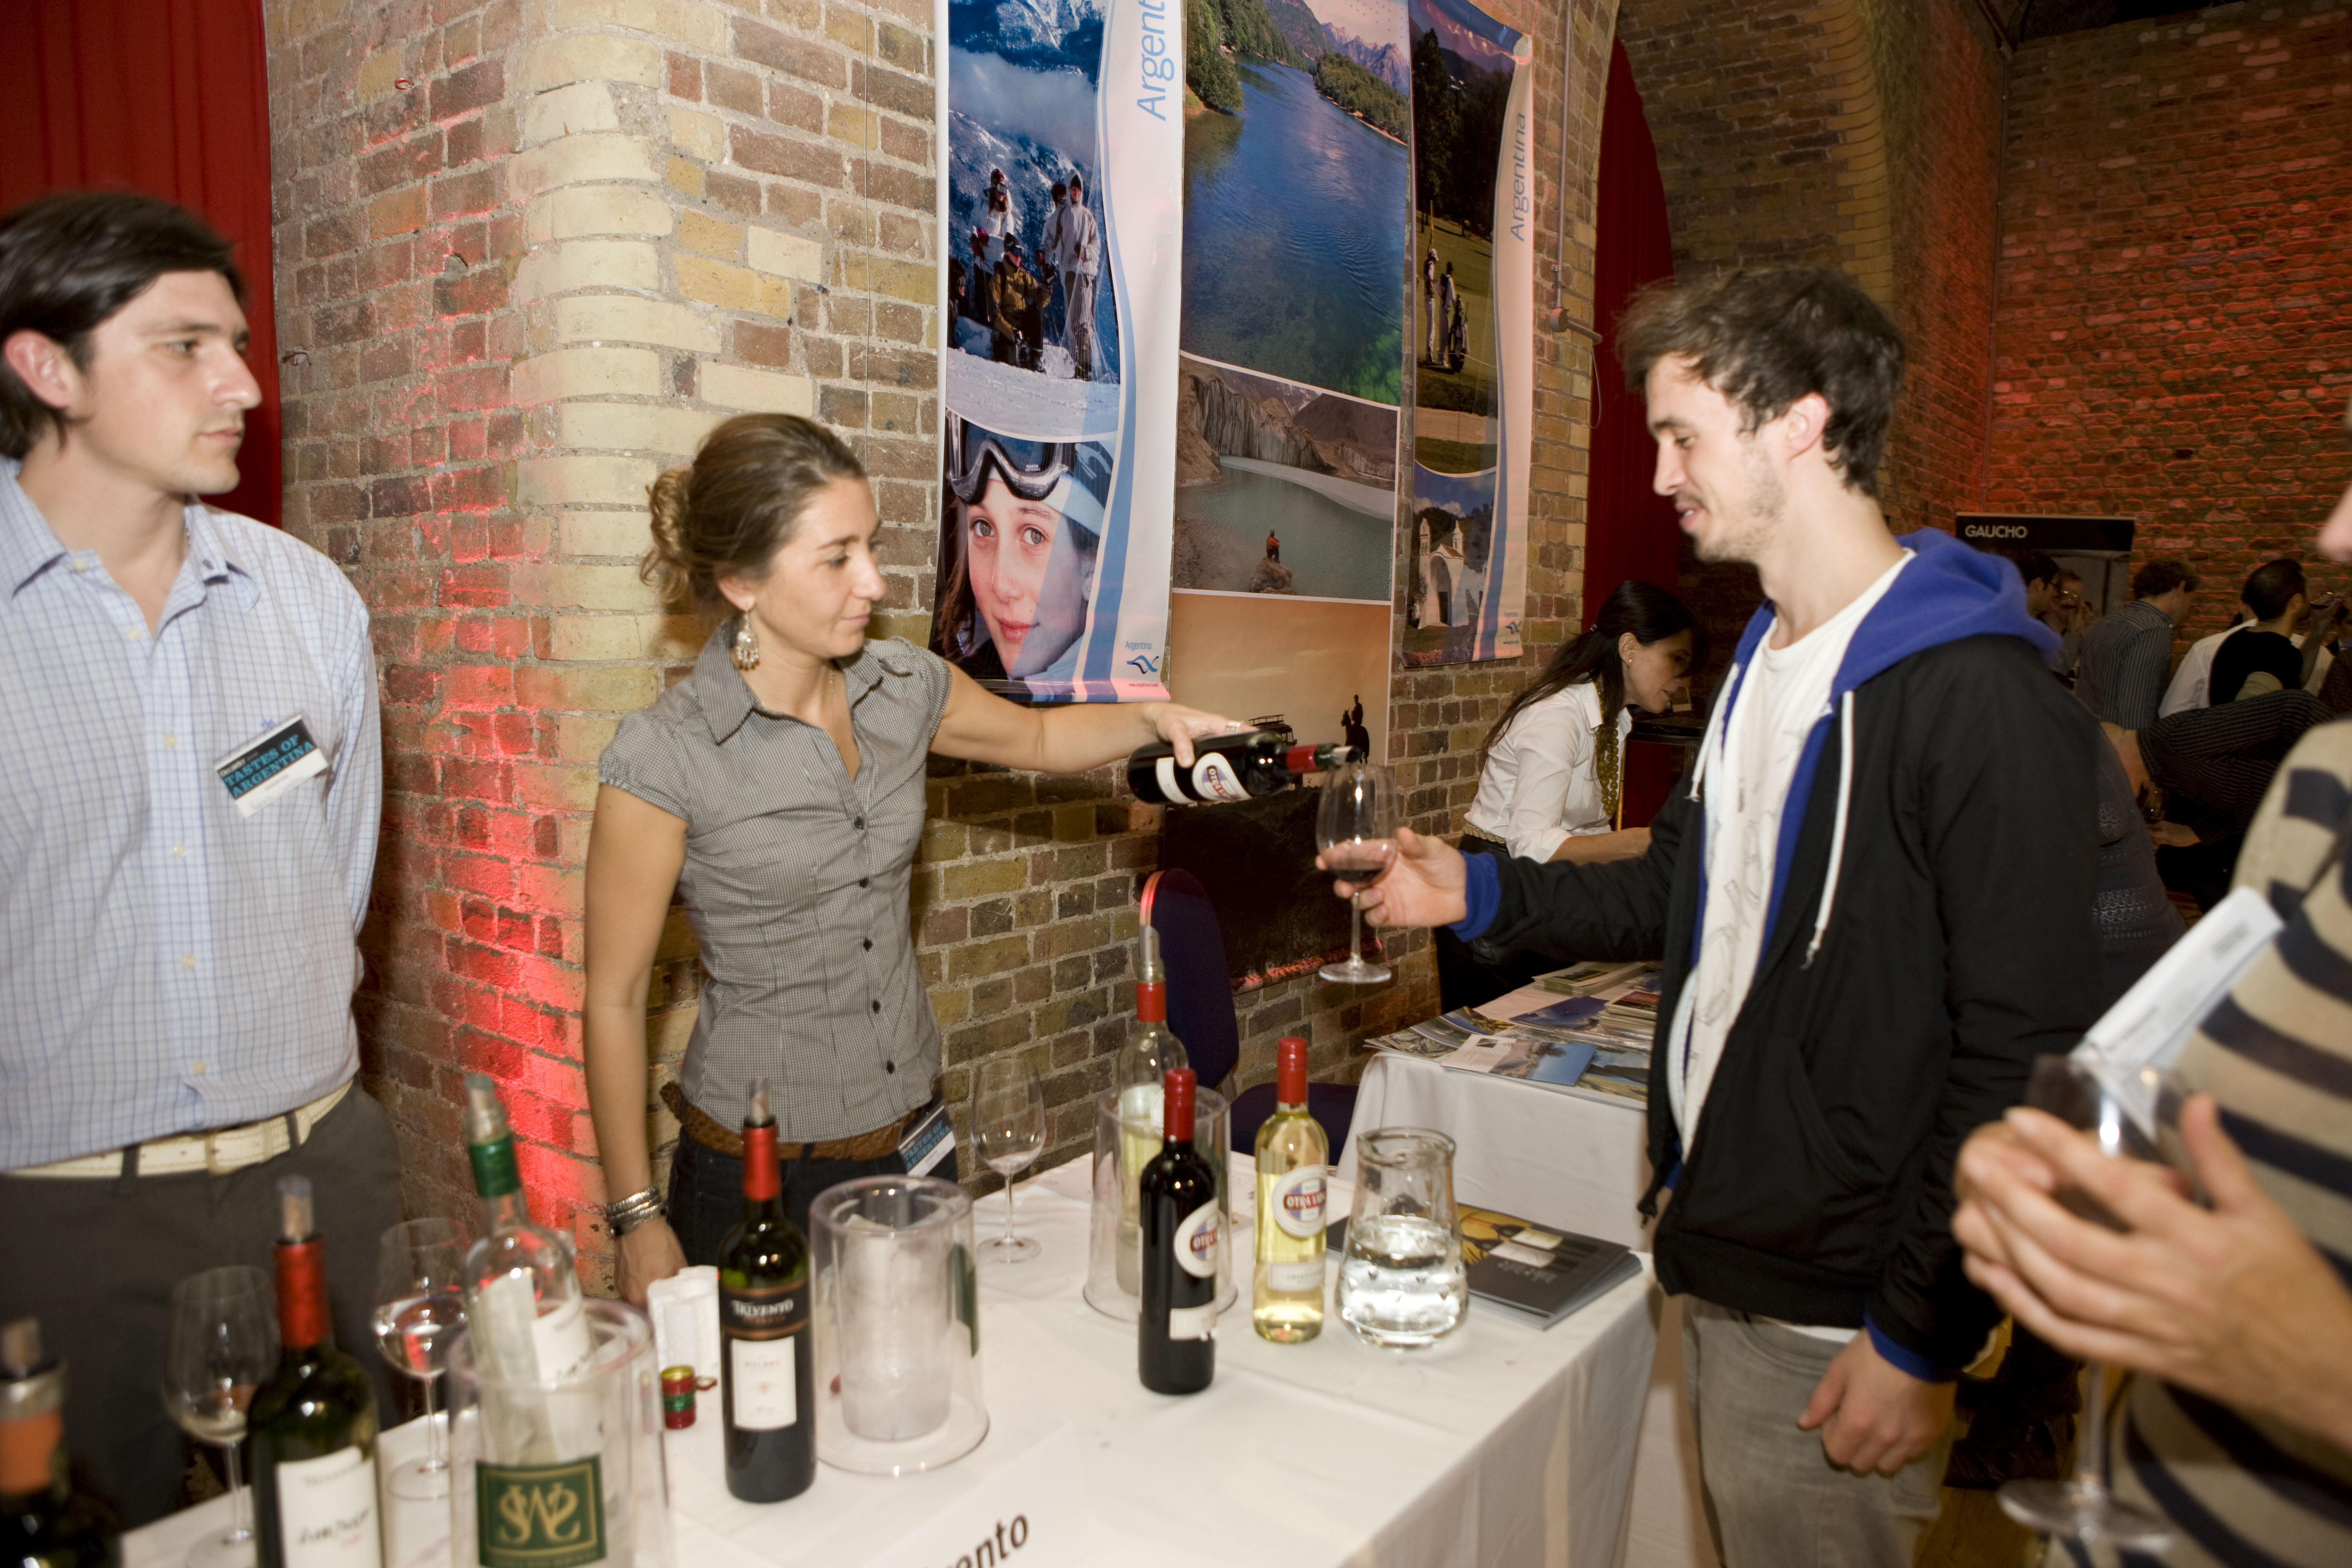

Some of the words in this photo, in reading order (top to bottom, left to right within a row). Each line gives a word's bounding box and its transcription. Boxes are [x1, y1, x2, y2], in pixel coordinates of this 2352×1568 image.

[1137, 0, 1175, 121] Argent
[1510, 113, 1529, 242] Argentina
[1965, 524, 2029, 539] GAUCHO
[1125, 641, 1152, 651] Argentina
[225, 748, 279, 786] TASTES
[280, 734, 299, 752] OF
[233, 741, 314, 798] ARGENTINA
[903, 1130, 933, 1162] TASTES
[933, 1119, 943, 1134] OF
[907, 1125, 951, 1171] ARGENTINA
[1286, 1195, 1311, 1209] OTRA
[731, 1298, 794, 1318] TRIVENTO
